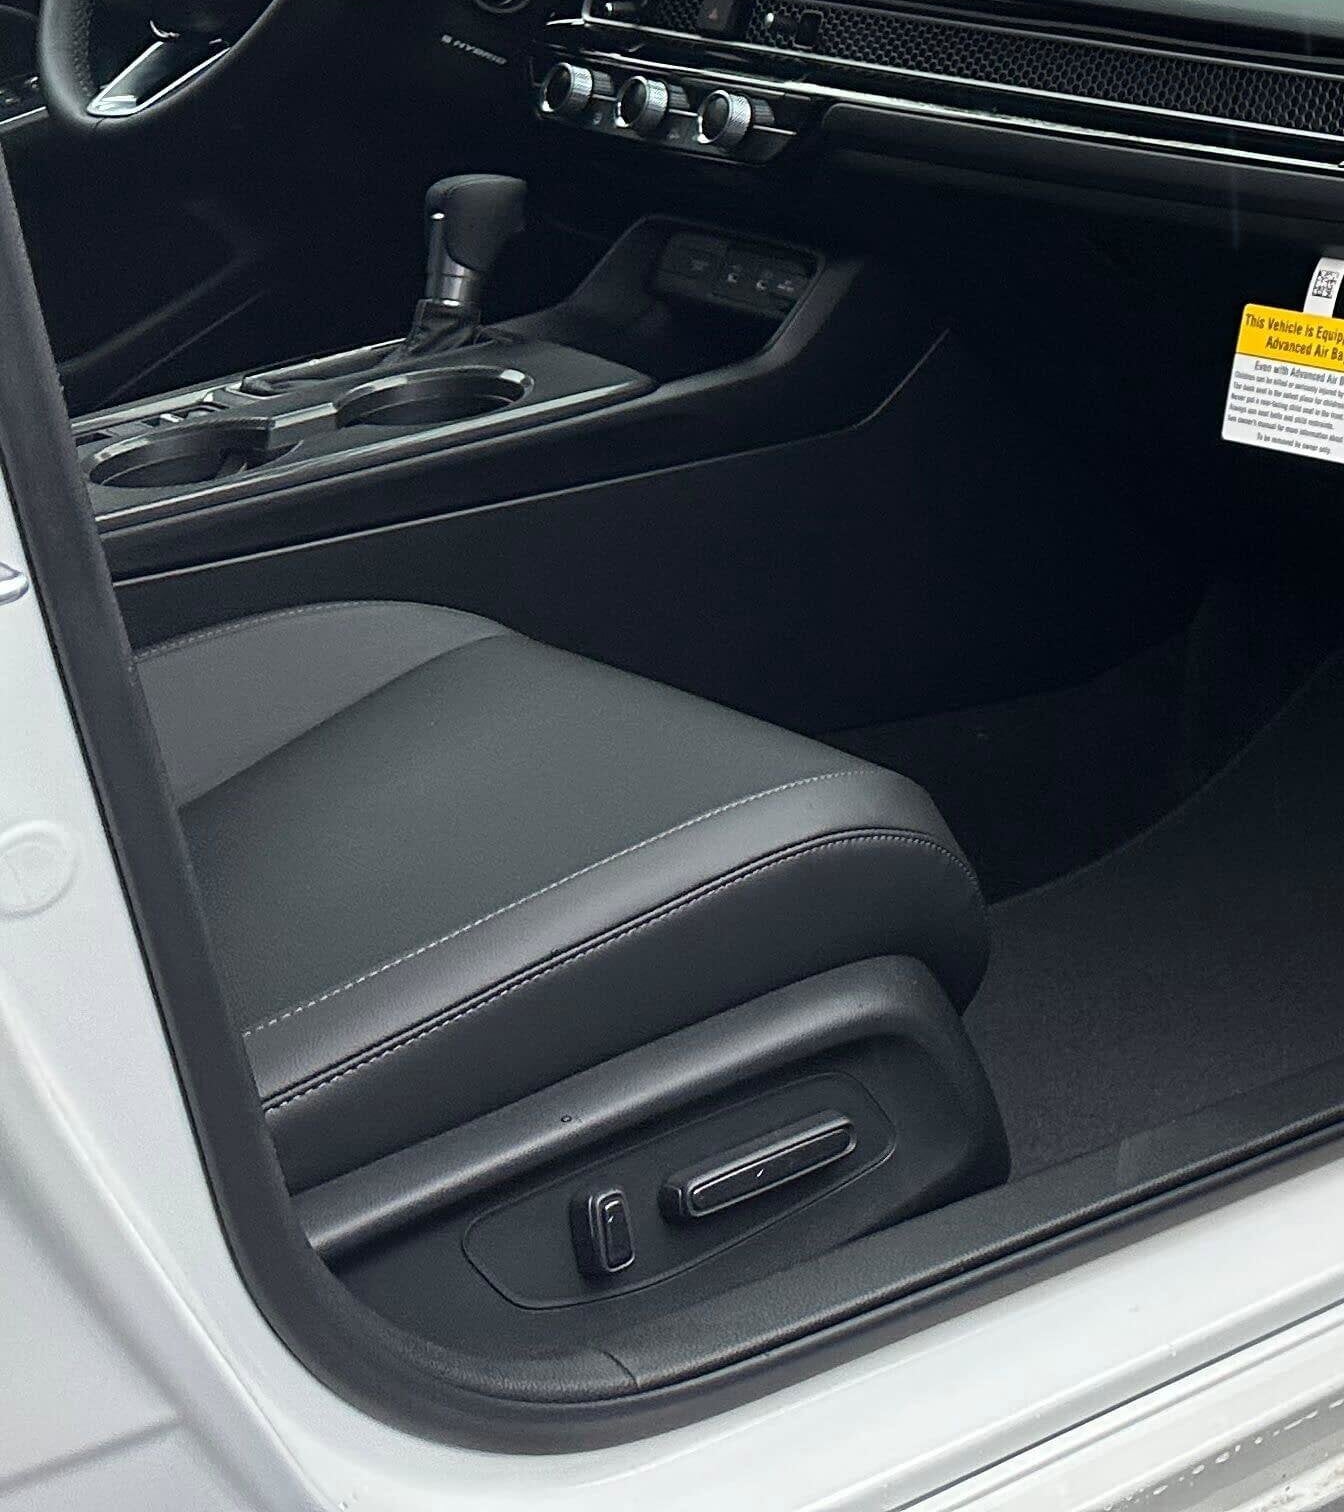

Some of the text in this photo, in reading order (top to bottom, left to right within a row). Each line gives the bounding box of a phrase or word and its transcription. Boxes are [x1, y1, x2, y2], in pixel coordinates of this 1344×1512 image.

[1245, 313, 1265, 329] This
[1268, 317, 1303, 335] Vehicle
[1265, 336, 1312, 355] Advanced
[1314, 344, 1329, 358] Air
